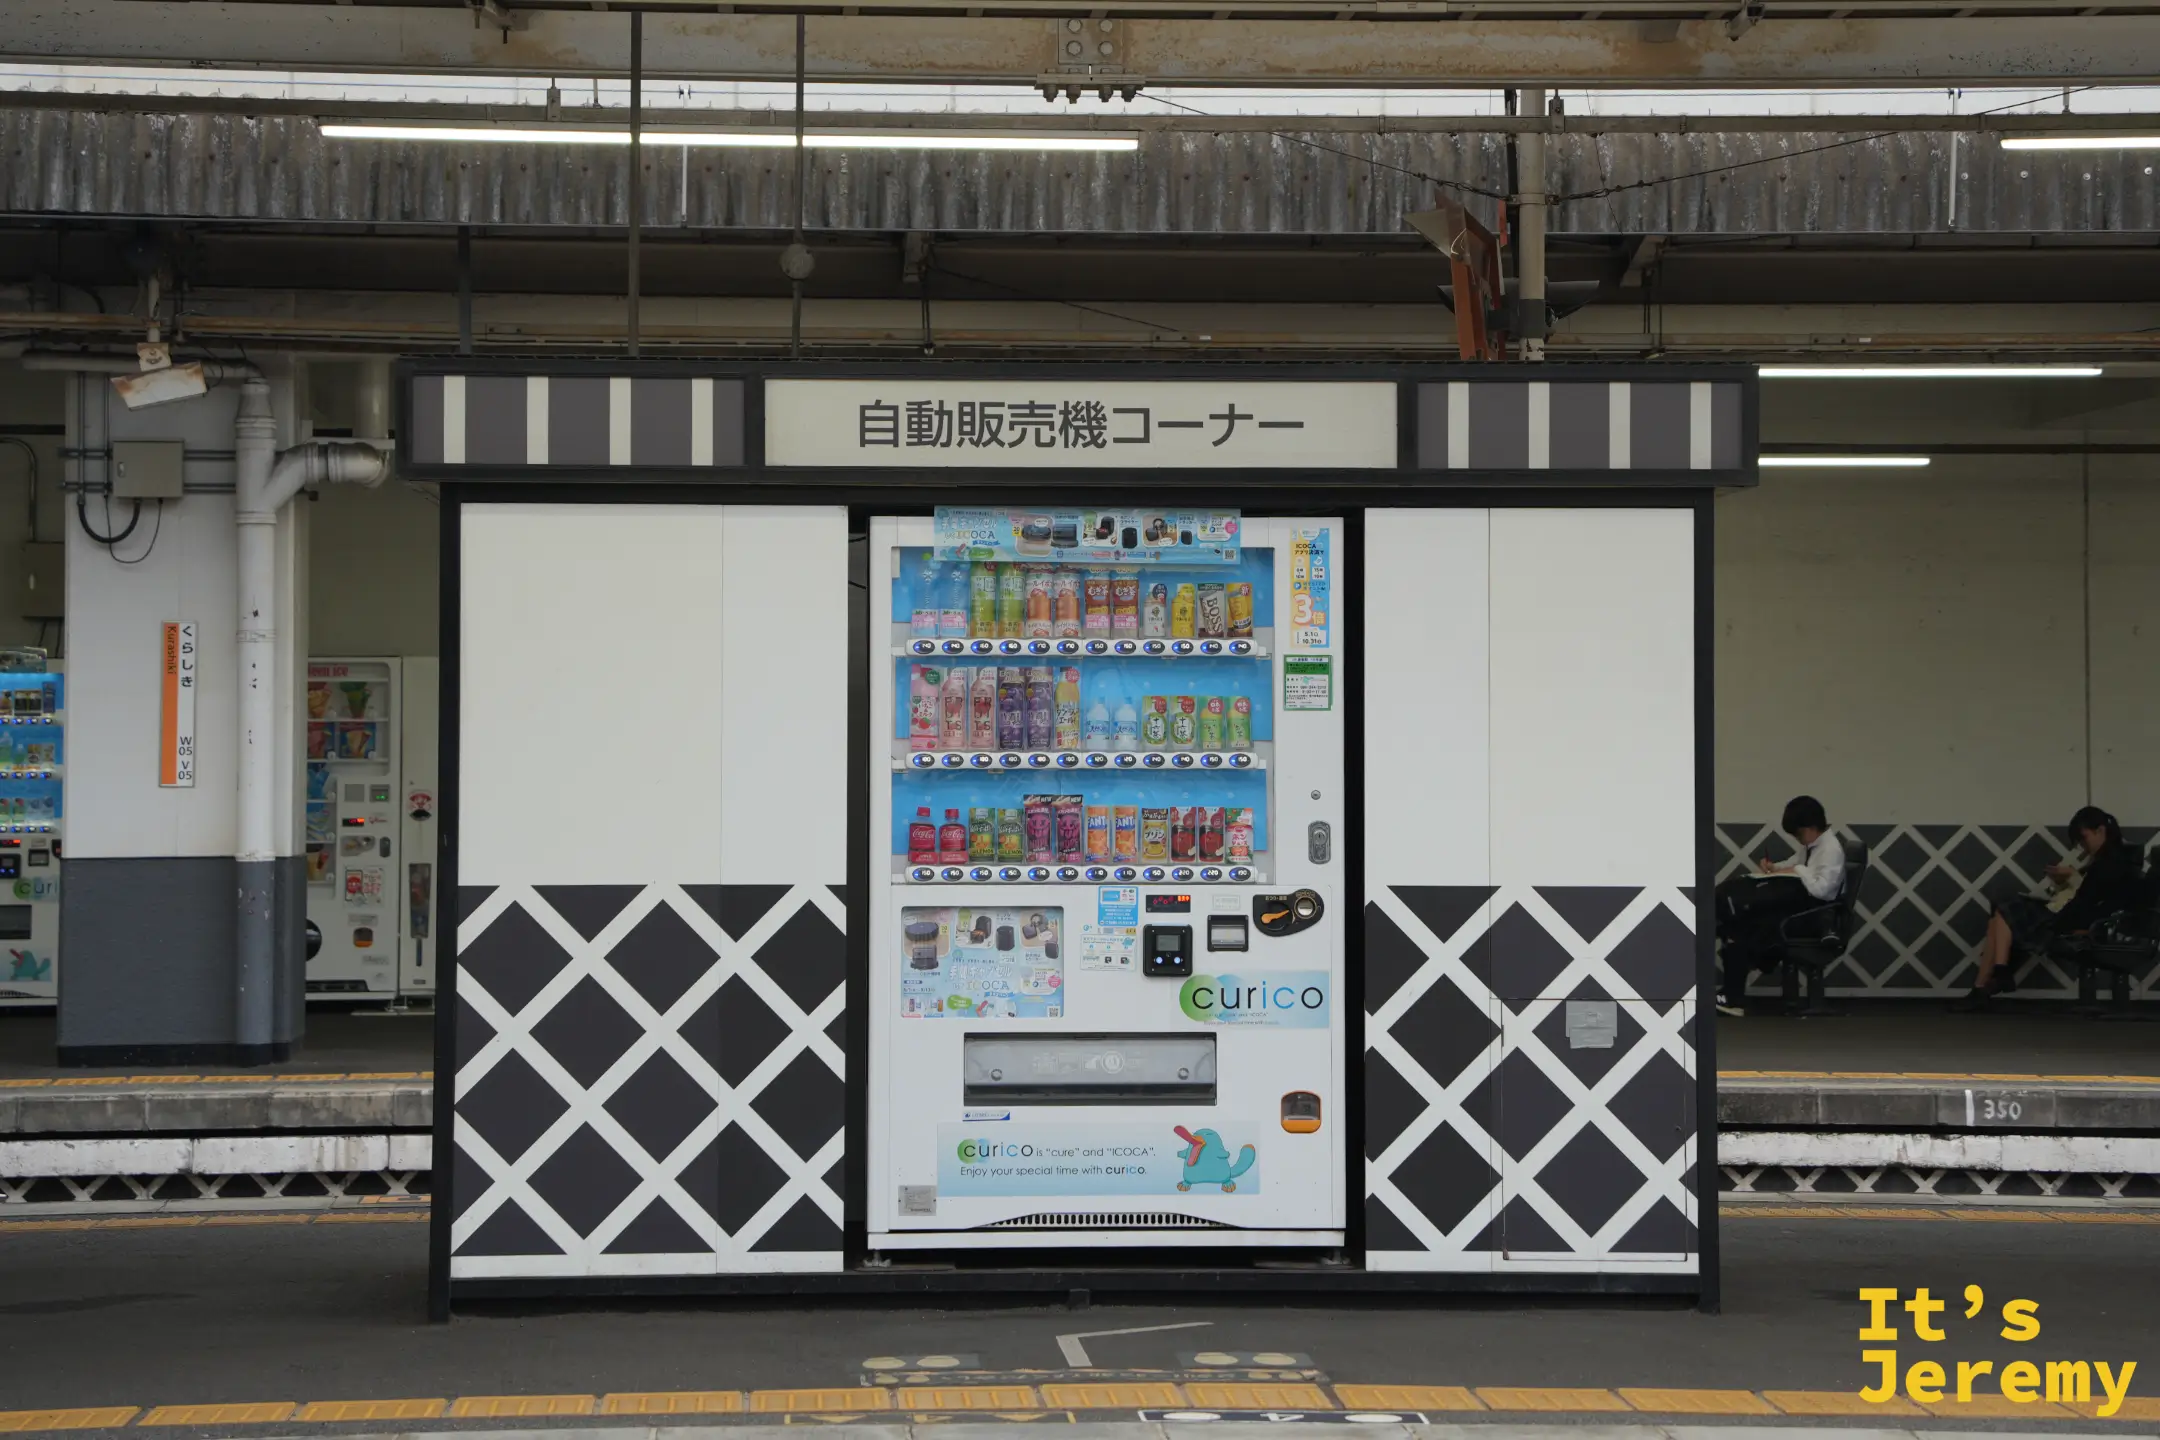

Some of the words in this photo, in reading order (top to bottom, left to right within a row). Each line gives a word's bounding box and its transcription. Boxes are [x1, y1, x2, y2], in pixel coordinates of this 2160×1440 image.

[858, 398, 1305, 449] 自動販売機コーナー
[1206, 596, 1223, 632] BOSS
[1294, 594, 1312, 624] 3
[1312, 611, 1325, 625] 倍
[167, 626, 177, 674] Kurashiki
[180, 625, 194, 688] くらしき
[1151, 717, 1162, 739] 十六茶
[1179, 717, 1190, 739] 十六茶
[180, 736, 192, 745] W
[178, 746, 193, 756] 05
[178, 770, 193, 780] 05
[181, 760, 190, 770] V
[1144, 831, 1165, 839] プリン
[967, 980, 1009, 991] ICOCA
[1192, 980, 1324, 1009] curico
[1983, 1100, 2022, 1120] 350
[964, 1141, 1034, 1158] curico
[1037, 1147, 1043, 1157] is
[1046, 1147, 1080, 1158] “cure”
[1083, 1147, 1104, 1157] and
[1107, 1146, 1156, 1157] “ICOCA”.
[960, 1166, 988, 1178] Enjoy
[991, 1168, 1014, 1178] your
[1016, 1166, 1053, 1177] special
[1056, 1165, 1079, 1175] time
[1082, 1165, 1103, 1175] with
[1105, 1164, 1147, 1175] curico.
